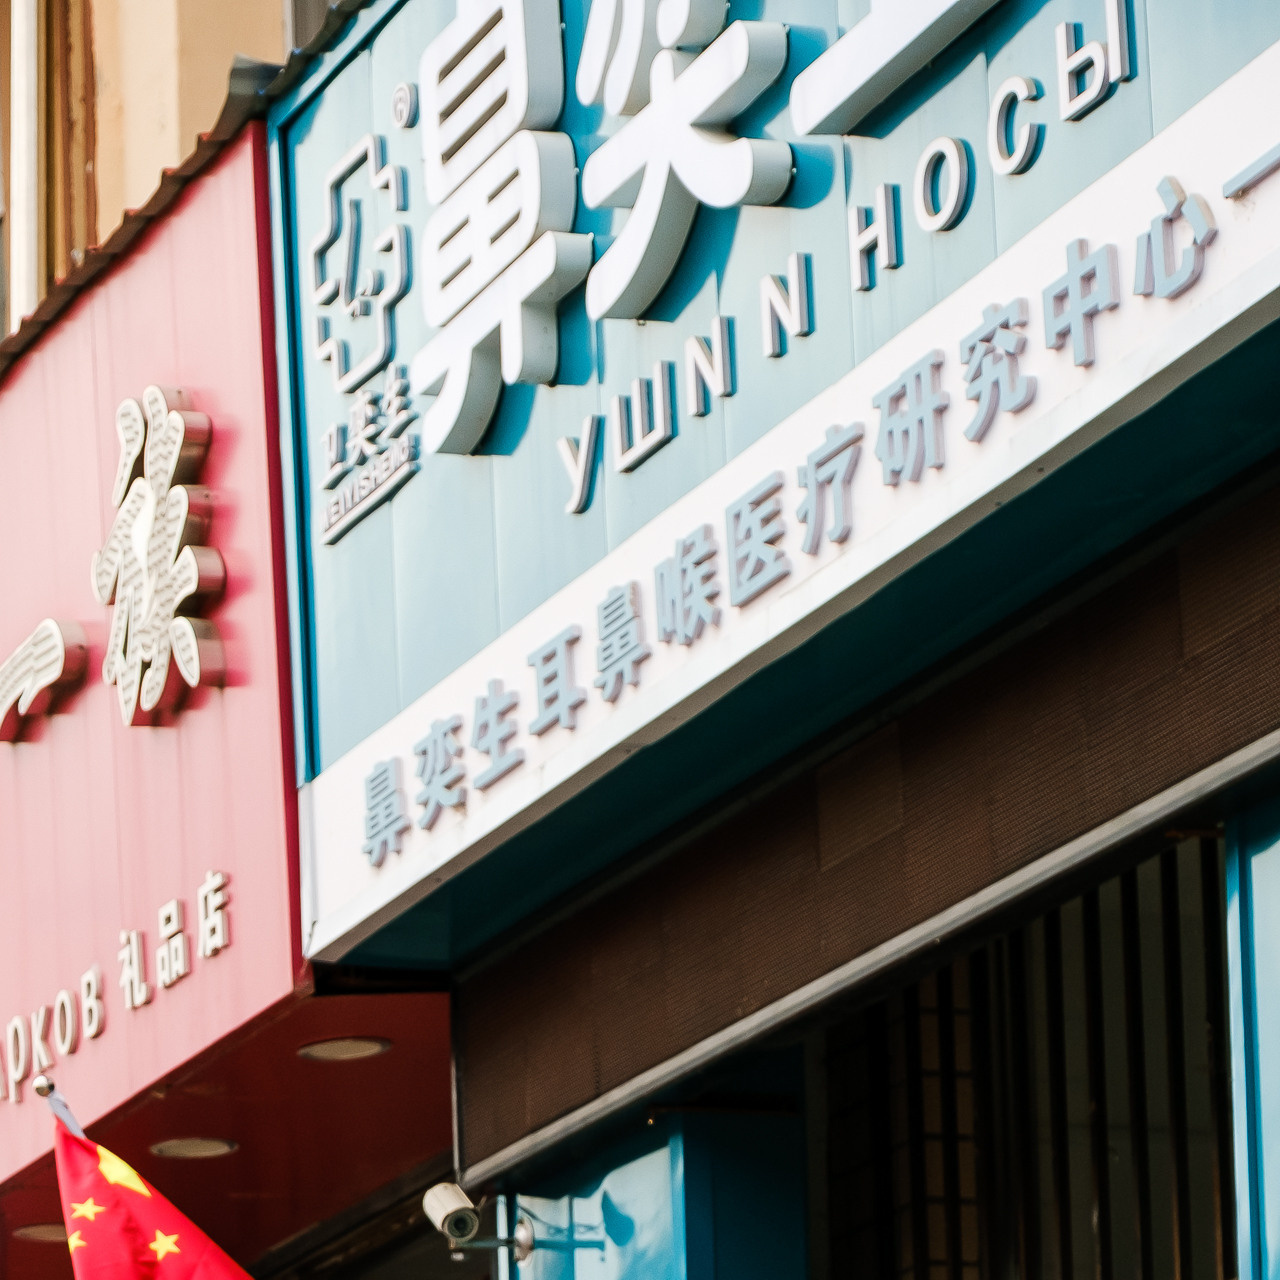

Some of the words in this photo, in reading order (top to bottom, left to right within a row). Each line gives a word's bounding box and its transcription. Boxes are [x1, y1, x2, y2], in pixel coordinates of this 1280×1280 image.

[412, 0, 1010, 455] 鼻奕
[118, 870, 230, 1009] 礼品店
